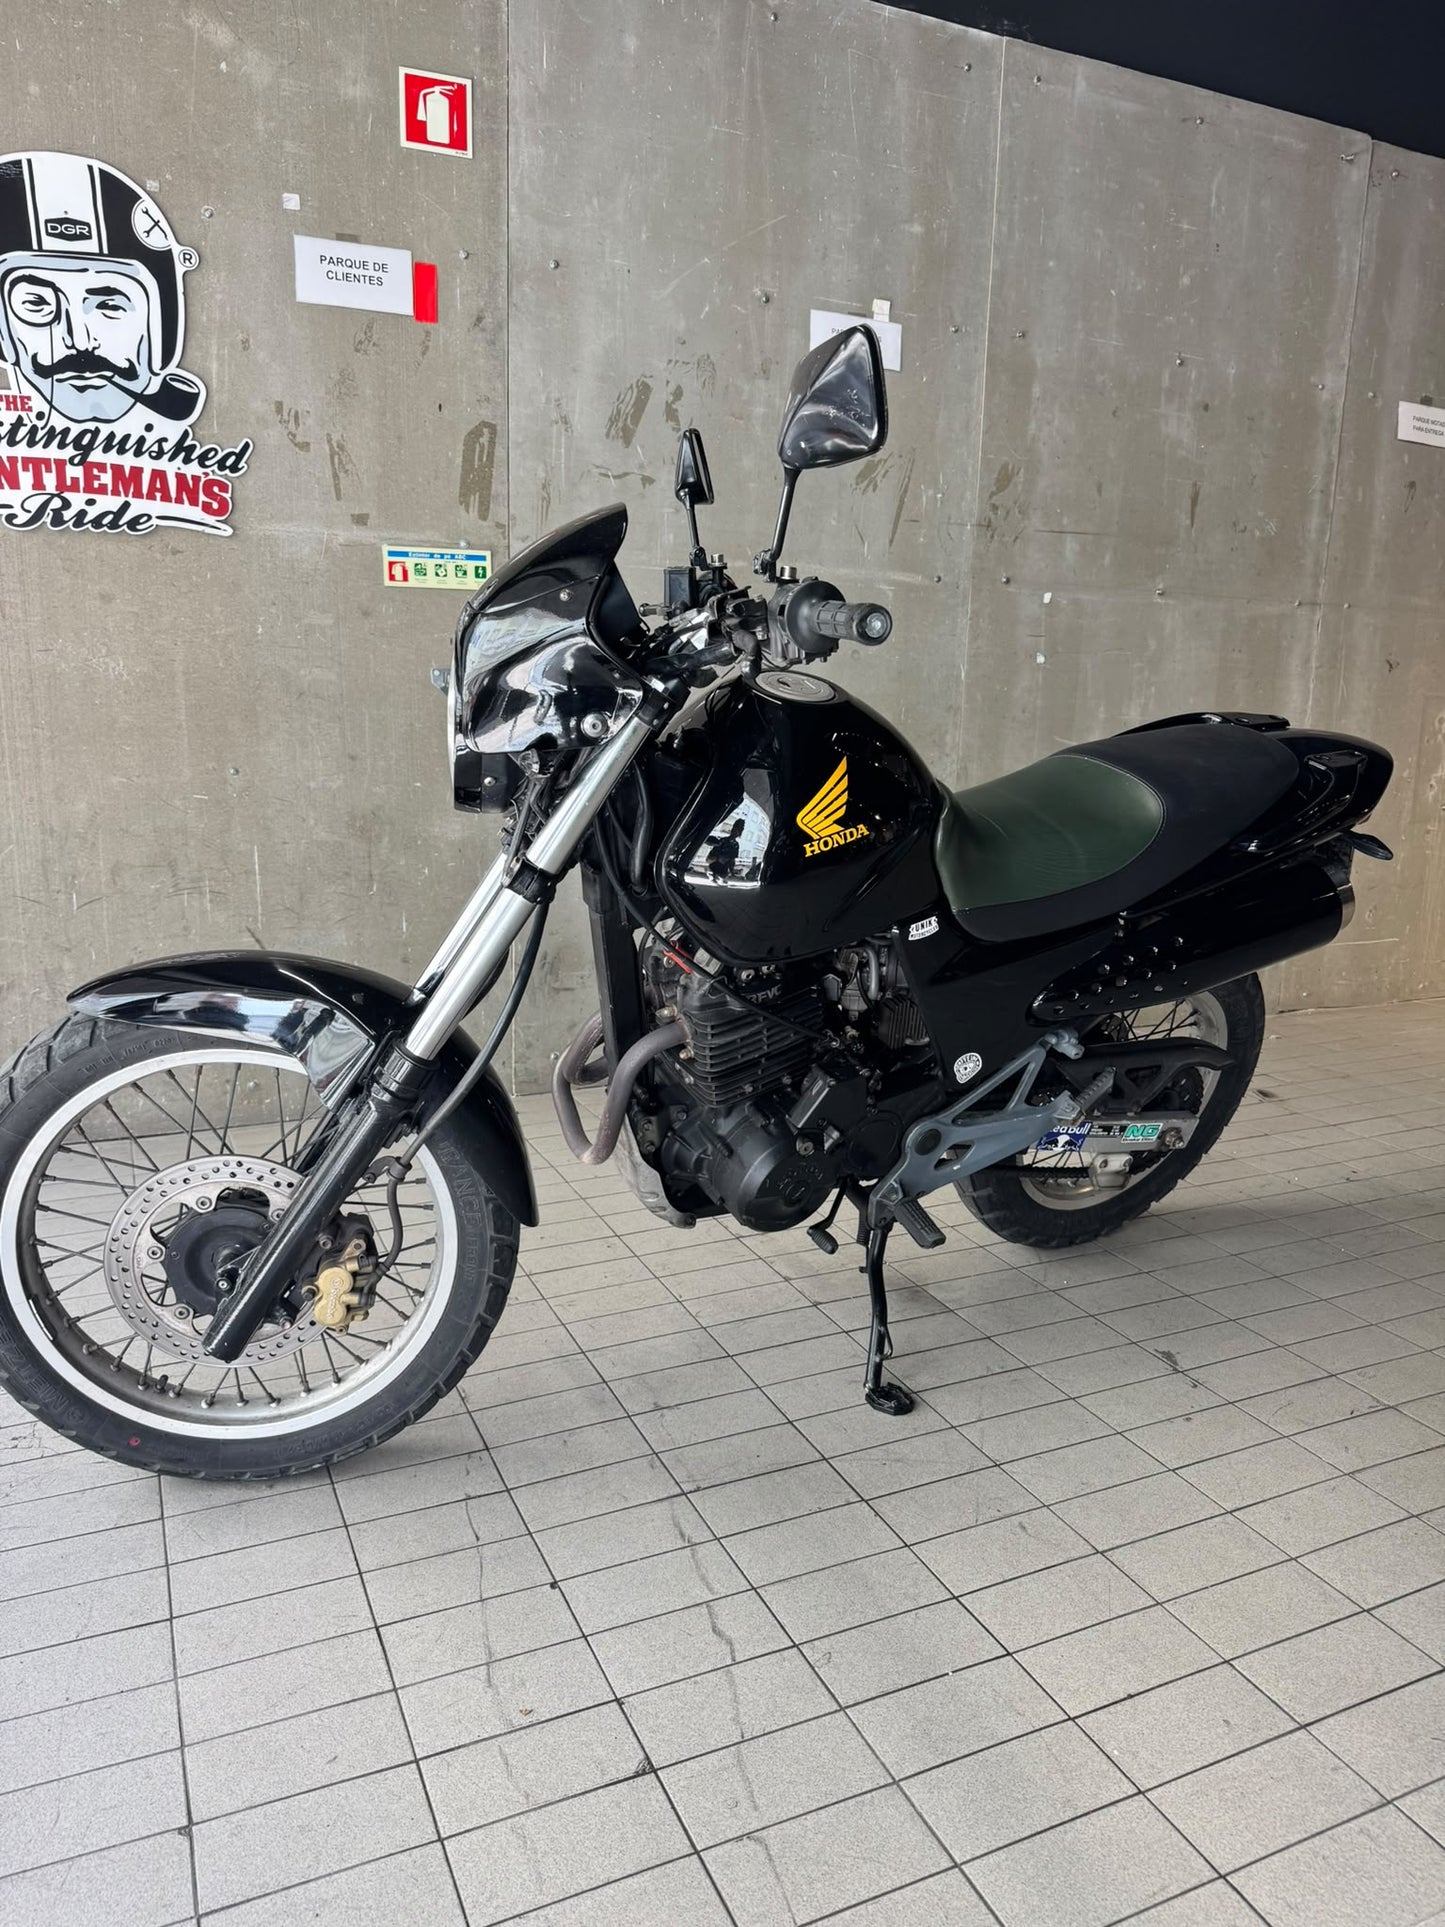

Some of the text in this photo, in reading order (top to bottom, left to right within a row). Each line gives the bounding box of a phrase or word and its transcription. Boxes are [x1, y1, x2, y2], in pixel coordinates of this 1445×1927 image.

[47, 222, 90, 236] DGR
[319, 255, 389, 273] PARQUE DE
[326, 270, 383, 286] CLIENTES
[4, 492, 154, 532] Ride
[803, 823, 869, 858] HONDA
[915, 919, 932, 932] UNIK
[1124, 1124, 1160, 1137] NG
